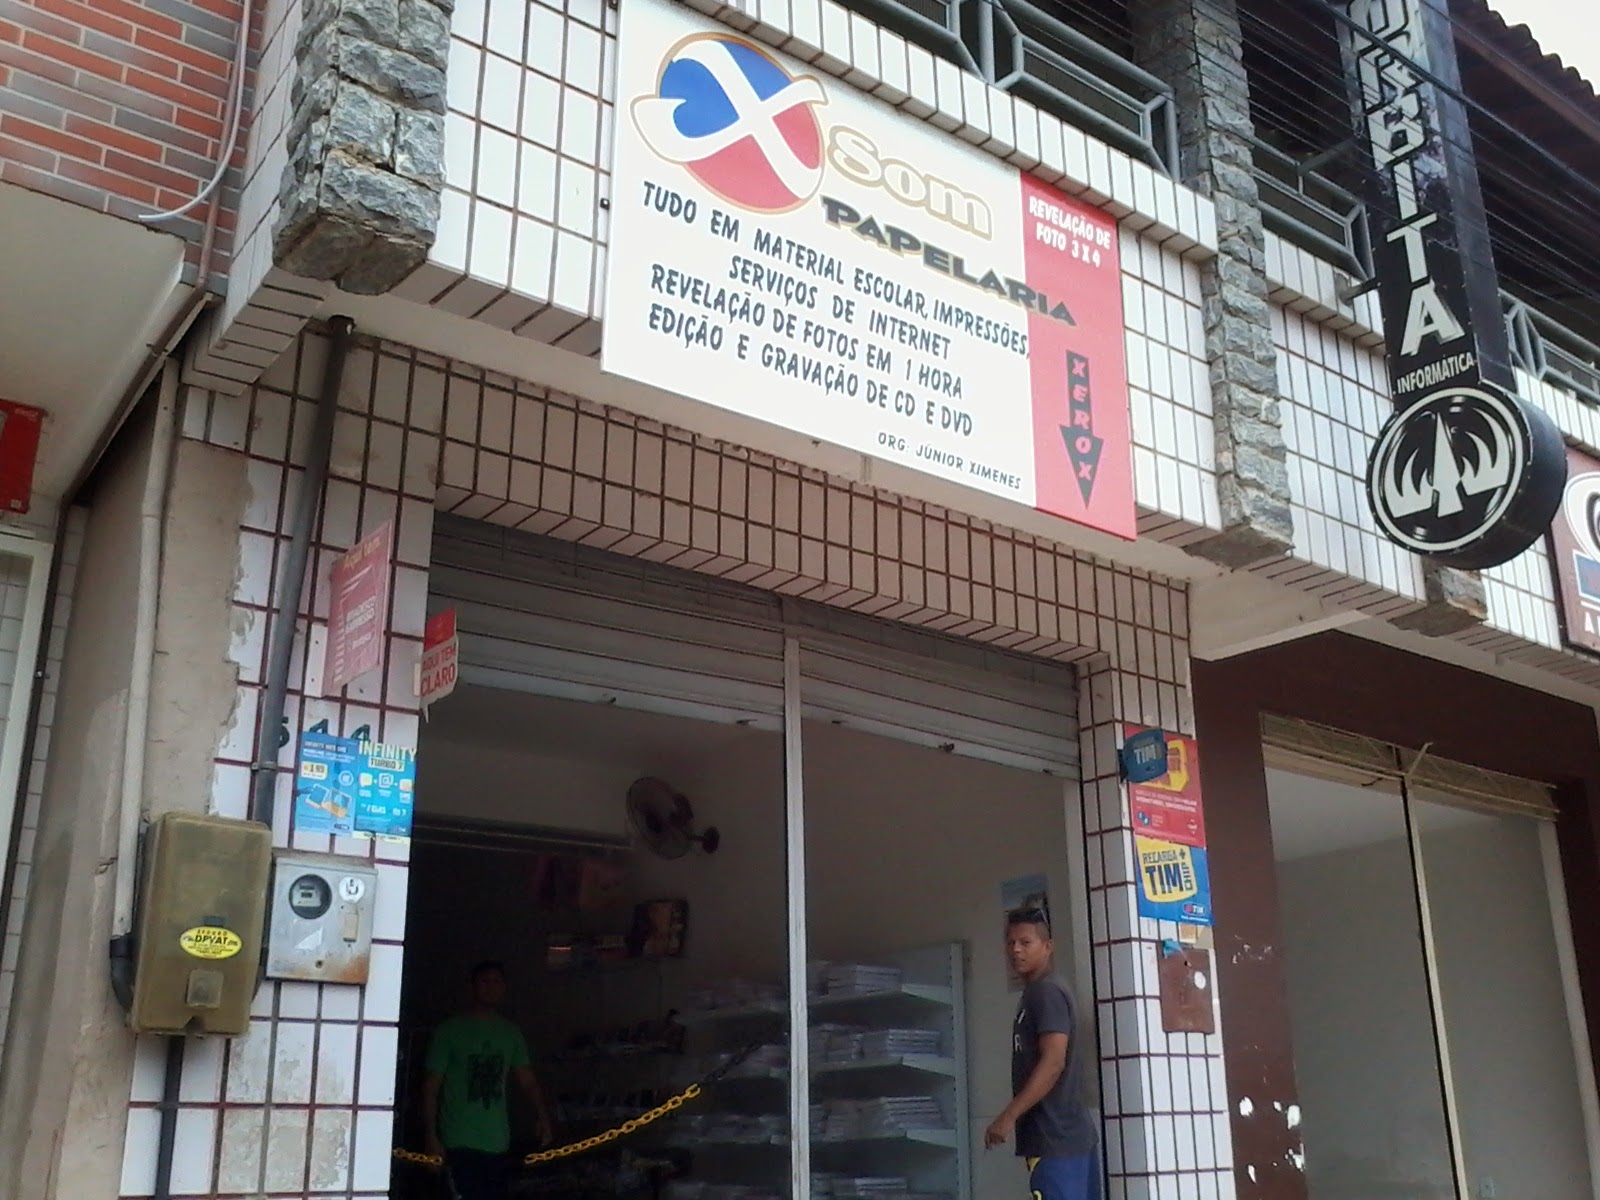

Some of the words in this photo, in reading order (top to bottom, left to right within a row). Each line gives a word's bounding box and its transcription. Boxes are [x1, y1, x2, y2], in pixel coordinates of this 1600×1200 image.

[828, 125, 992, 241] Som
[1029, 195, 1094, 241] REVELAÇÃO
[1095, 226, 1111, 250] DE
[1036, 221, 1067, 251] FOTO
[1071, 239, 1079, 259] 3
[1081, 243, 1091, 264] X
[1092, 248, 1101, 269] 4
[643, 180, 698, 224] TUDO
[710, 208, 740, 243] EM
[753, 227, 845, 286] MATERIAL
[933, 299, 1030, 360] IMPRESSÕES,
[819, 194, 1077, 326] PAPELARIA
[650, 263, 766, 328] REVELAÇÃO
[772, 307, 798, 340] DE
[803, 320, 859, 362] FOTOS
[866, 343, 892, 375] EM
[905, 358, 913, 382] 1
[918, 366, 963, 400] HORA
[729, 255, 818, 310] SERVIÇOS
[832, 294, 856, 324] DE
[868, 308, 951, 361] INTERNET
[649, 302, 724, 352] EDIÇÃO
[737, 333, 750, 360] E
[761, 342, 859, 398] GRAVAÇÃO
[866, 378, 889, 409] DE
[894, 390, 916, 418] CD
[926, 400, 936, 426] E
[941, 409, 974, 438] DVD
[1071, 358, 1093, 482] XEROX
[916, 443, 964, 472] JÚNIOR
[968, 460, 1021, 490] XIMENES
[421, 663, 455, 697] CLARO
[358, 740, 417, 762] INFINITY
[1133, 744, 1156, 764] TIM
[1142, 851, 1177, 864] RECARGA
[1145, 863, 1183, 895] TIM
[195, 935, 228, 945] DPVAT
